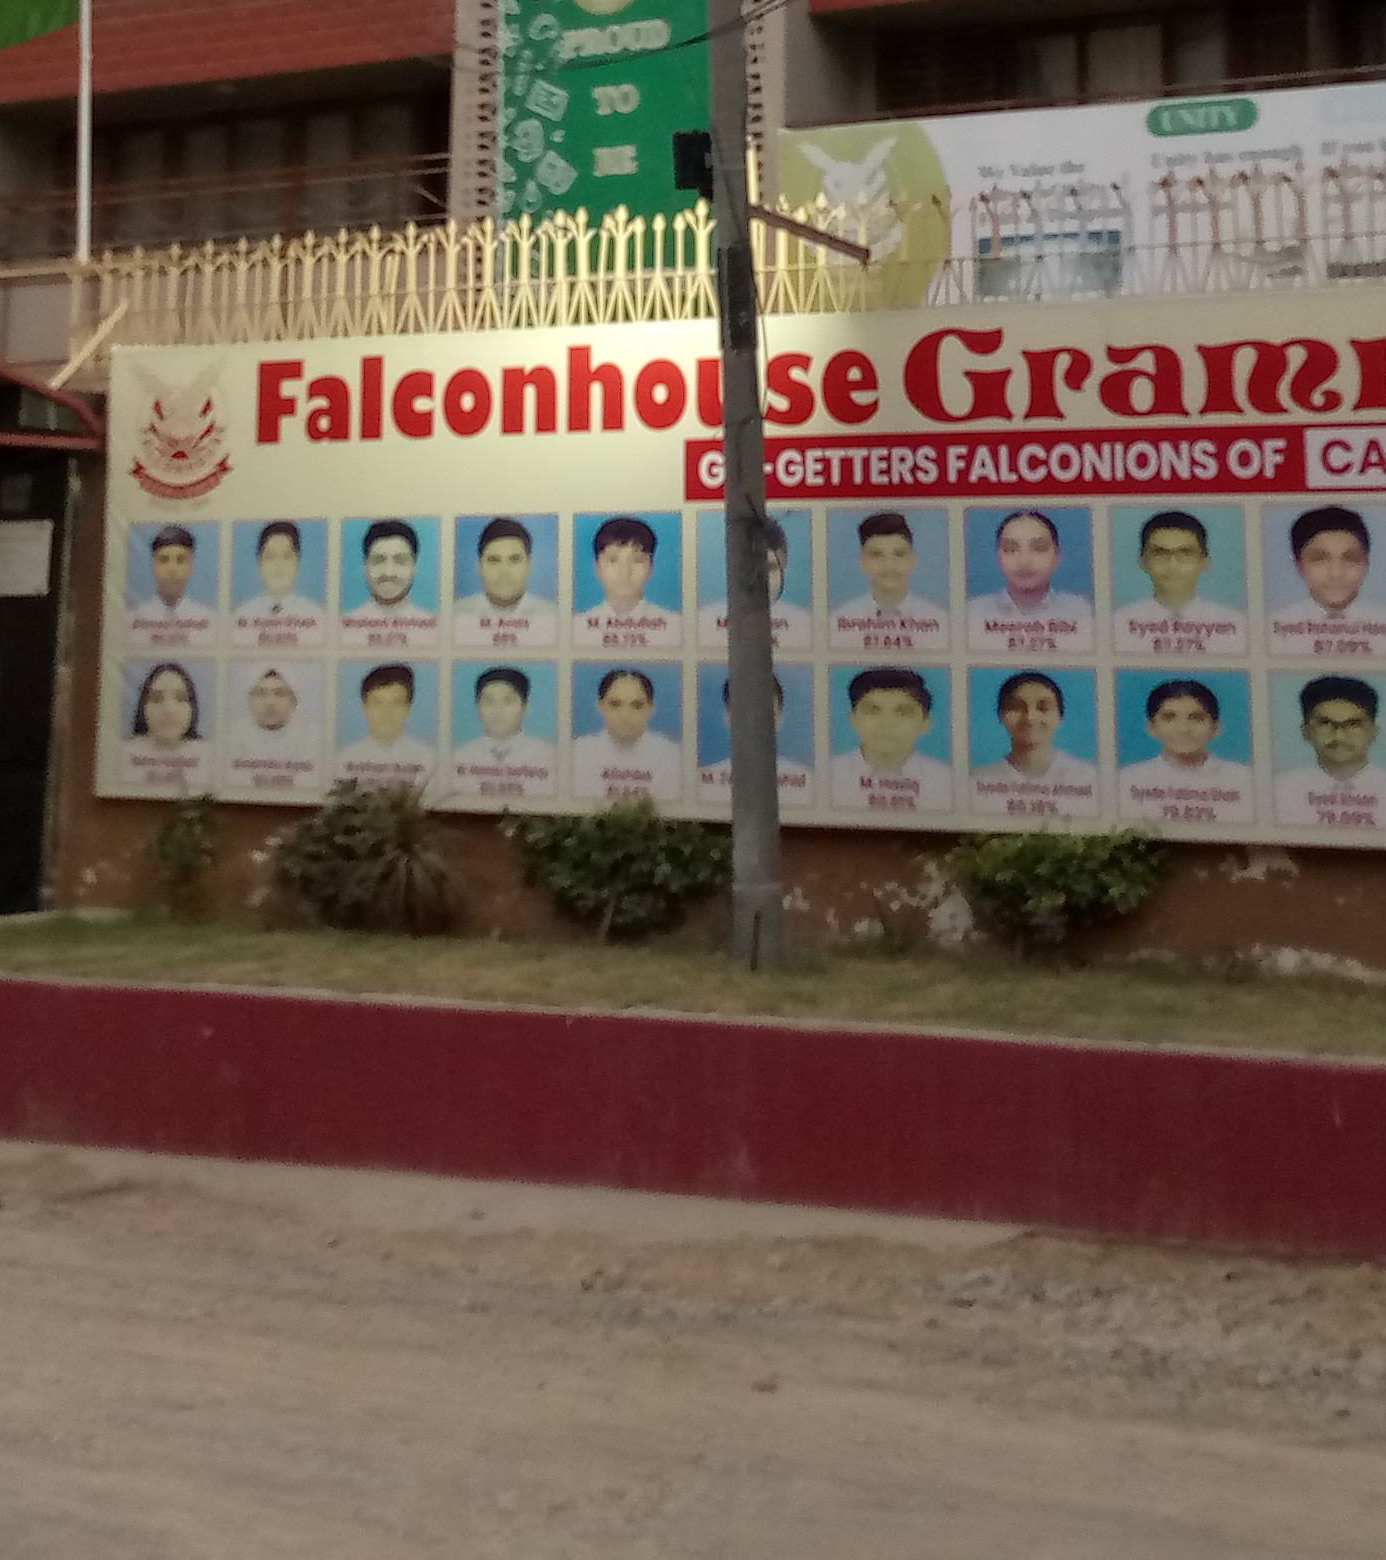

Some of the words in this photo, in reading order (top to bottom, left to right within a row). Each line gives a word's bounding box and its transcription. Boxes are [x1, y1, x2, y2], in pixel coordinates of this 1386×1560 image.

[698, 444, 941, 489] G-GETTERS
[945, 439, 1218, 486] FALCONIONS
[1226, 438, 1287, 480] OF
